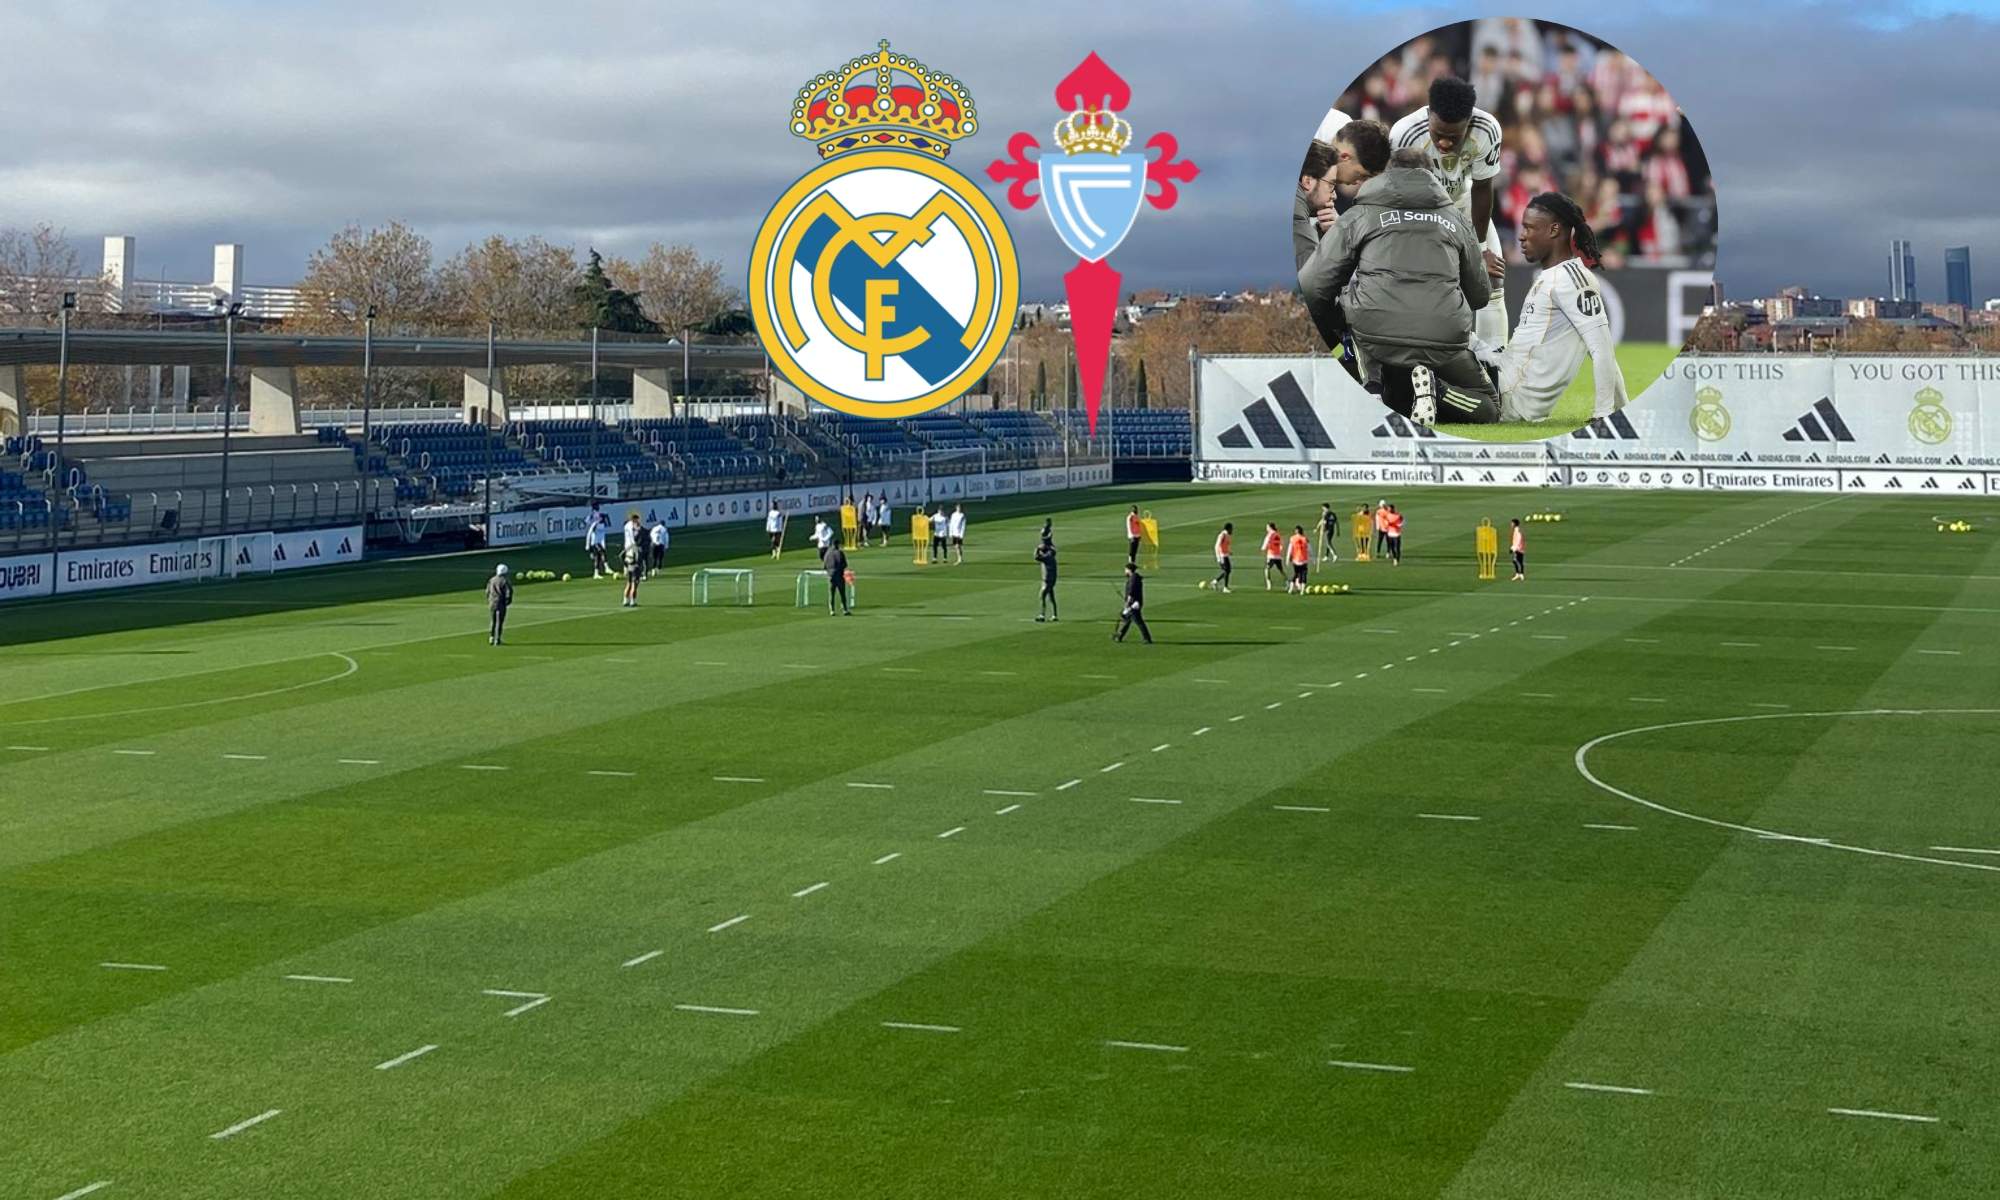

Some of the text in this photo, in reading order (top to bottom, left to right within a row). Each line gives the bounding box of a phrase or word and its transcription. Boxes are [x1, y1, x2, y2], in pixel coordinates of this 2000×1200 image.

[1403, 211, 1457, 233] Sanitas
[1578, 290, 1602, 316] hp
[1683, 363, 1728, 380] GOT
[1734, 363, 1784, 380] THIS
[1849, 363, 1893, 381] YOU
[1902, 363, 1948, 381] GOT
[1202, 466, 1313, 479] Emirates Emirates
[1323, 467, 1377, 480] Emirates
[1707, 472, 1767, 486] Emirates
[1772, 473, 1834, 487] Emirates
[547, 516, 587, 534] Emrates
[67, 557, 134, 582] Emirates
